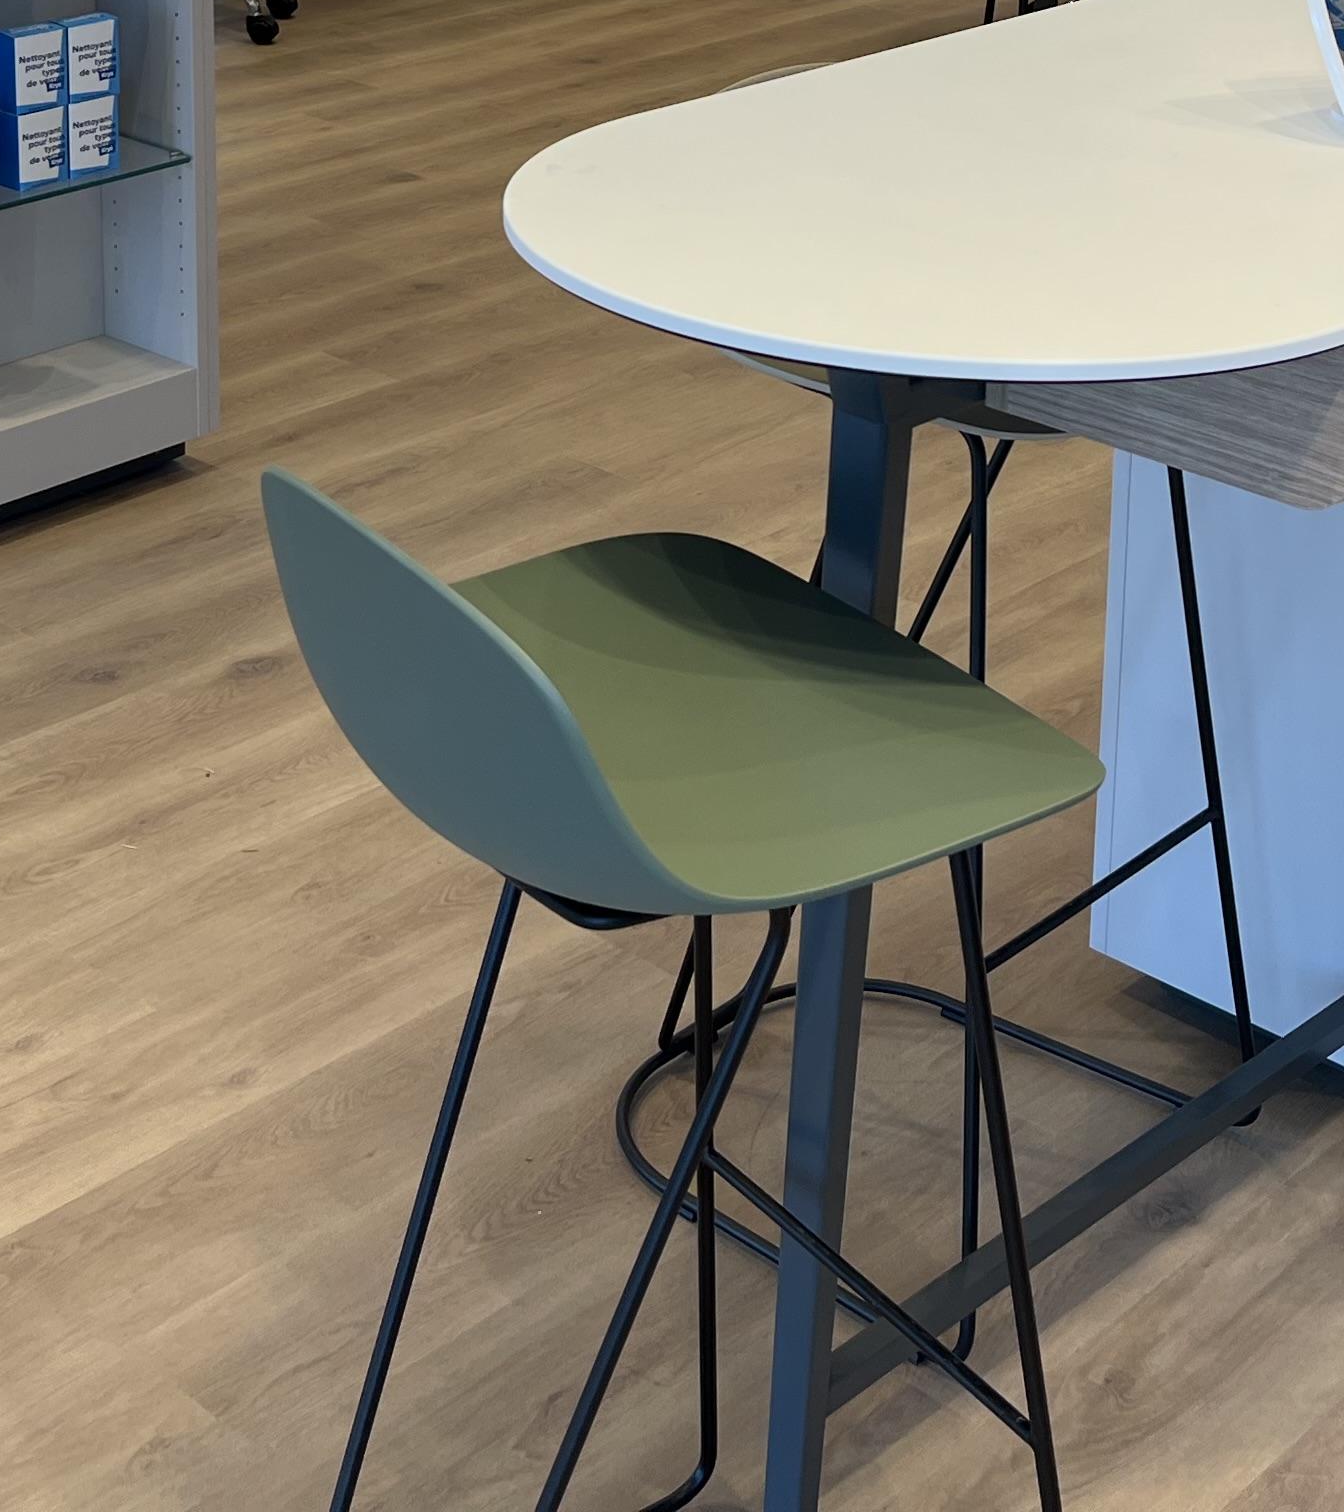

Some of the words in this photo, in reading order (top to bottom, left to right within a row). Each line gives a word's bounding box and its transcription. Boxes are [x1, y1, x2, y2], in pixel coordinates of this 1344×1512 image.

[72, 40, 112, 53] Nettoyant
[19, 50, 60, 64] Nettoyant
[78, 51, 97, 62] pour
[25, 63, 44, 73] pour
[79, 68, 90, 77] de
[26, 79, 37, 88] de
[72, 115, 113, 129] Nettoyant
[22, 126, 62, 141] Nettoyant
[78, 128, 97, 138] pour
[28, 140, 47, 150] pour
[79, 144, 90, 152] de
[29, 157, 40, 165] de
